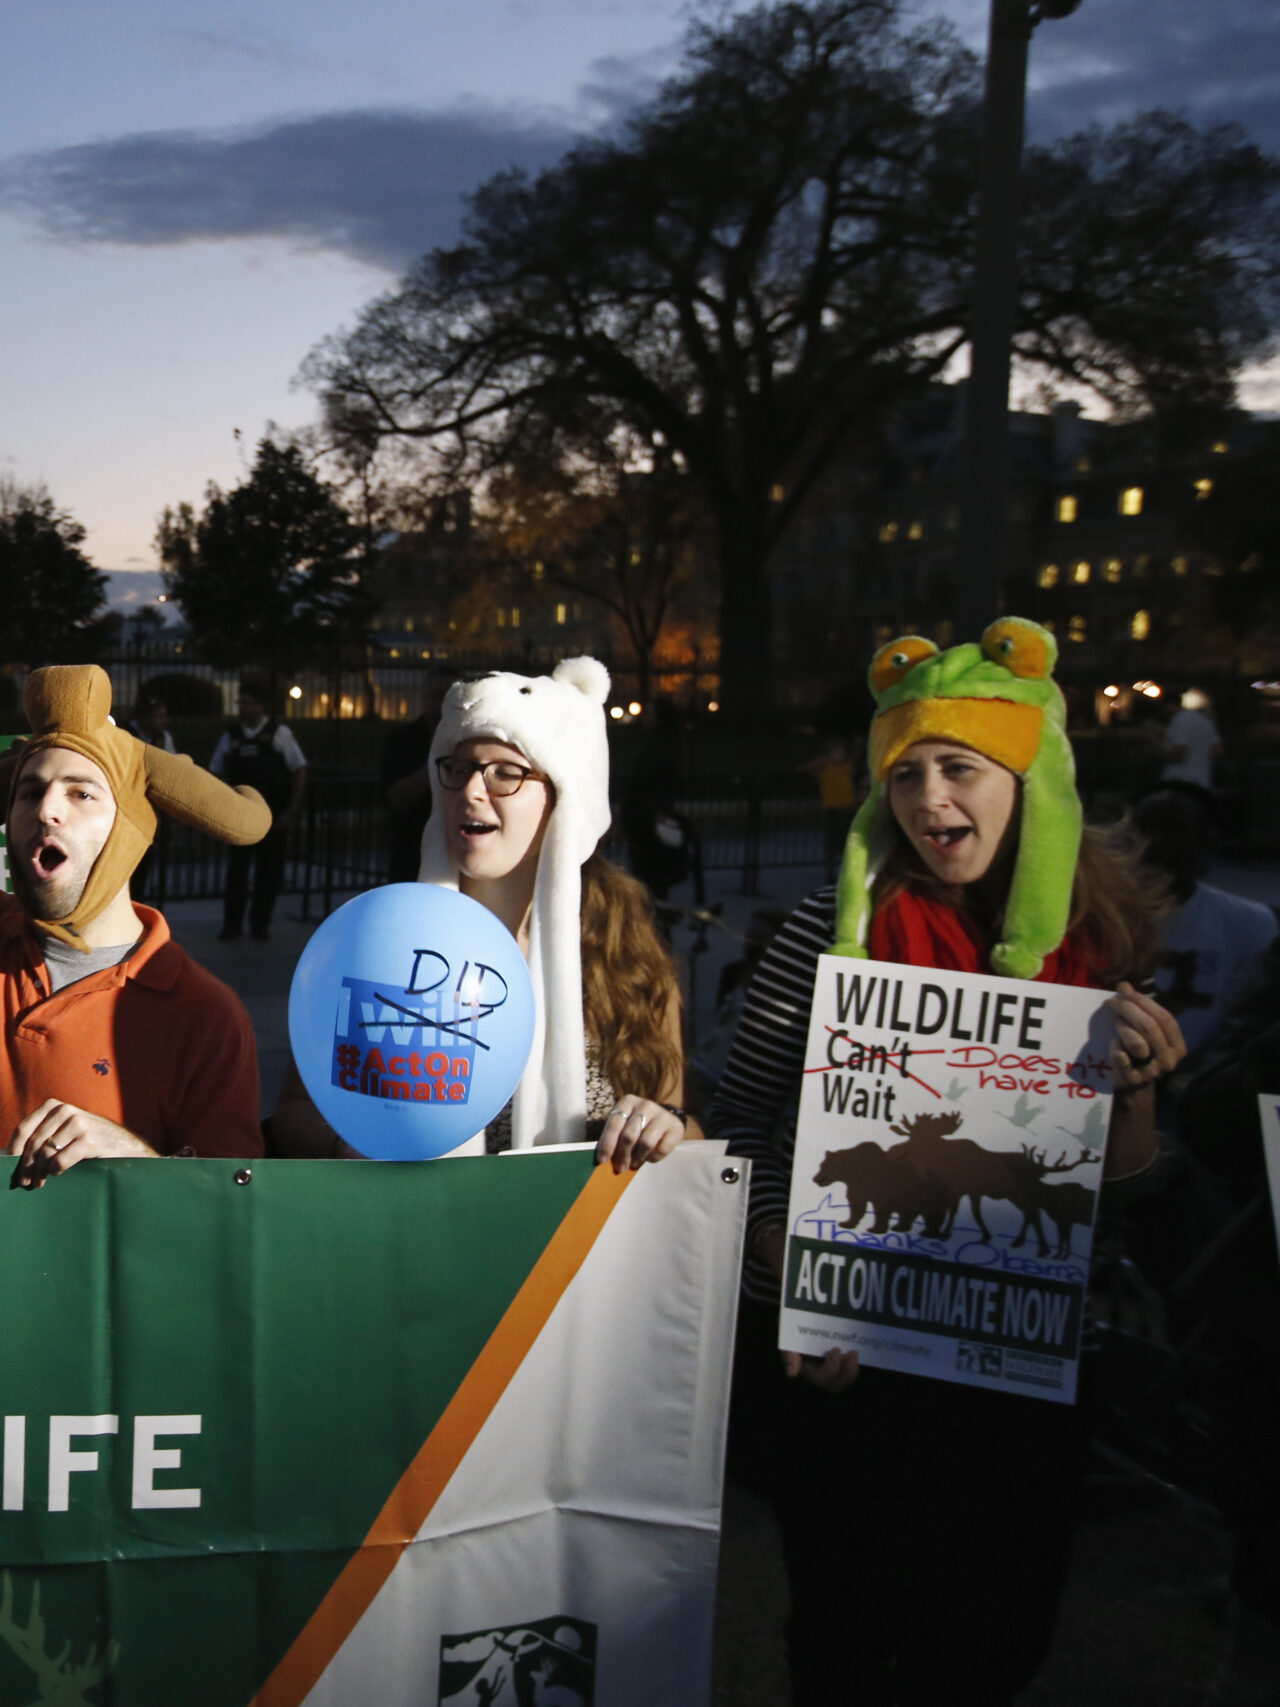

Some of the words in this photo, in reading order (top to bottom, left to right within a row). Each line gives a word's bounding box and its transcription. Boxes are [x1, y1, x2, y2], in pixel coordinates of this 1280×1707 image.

[404, 949, 509, 1008] DID
[835, 972, 1047, 1050] WILDLIFE
[336, 1043, 471, 1077] #ActOn
[826, 1028, 912, 1078] Can't
[946, 1046, 1113, 1080] Doesn't
[338, 1068, 467, 1101] Climate
[822, 1073, 896, 1123] Wait
[979, 1069, 1050, 1095] have
[802, 1218, 949, 1258] Thanks
[955, 1240, 1086, 1284] Obama
[794, 1248, 846, 1303] ACT
[847, 1259, 885, 1313] ON
[890, 1266, 999, 1334] CLIMATE
[1001, 1280, 1071, 1346] NOW
